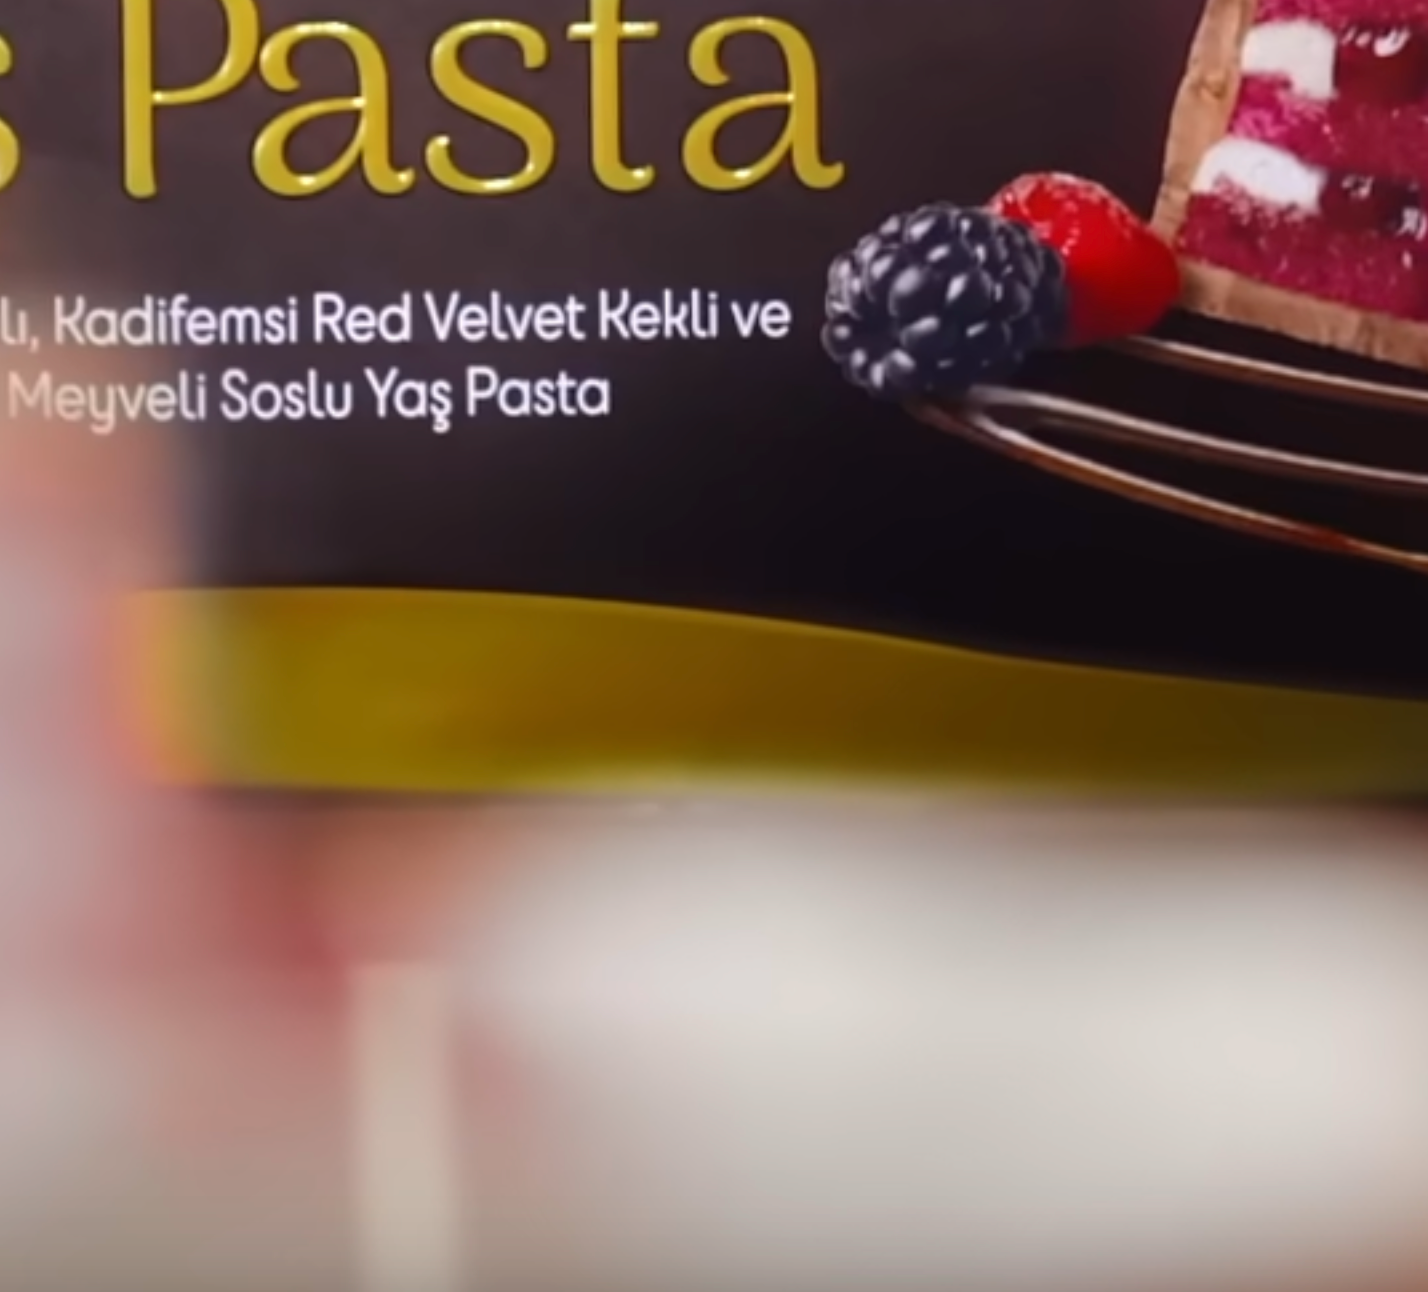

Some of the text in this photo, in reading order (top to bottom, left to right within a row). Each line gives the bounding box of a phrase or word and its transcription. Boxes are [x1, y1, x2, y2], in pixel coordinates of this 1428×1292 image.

[54, 295, 299, 348] Kadifemsi
[312, 292, 412, 344] Red
[423, 291, 586, 342] Velvet
[598, 289, 719, 341] Kekli
[730, 300, 792, 339] ve
[7, 371, 209, 436] Meyveli
[219, 368, 354, 421] Soslu
[365, 368, 453, 434] Yaş
[466, 366, 612, 417] Pasta
